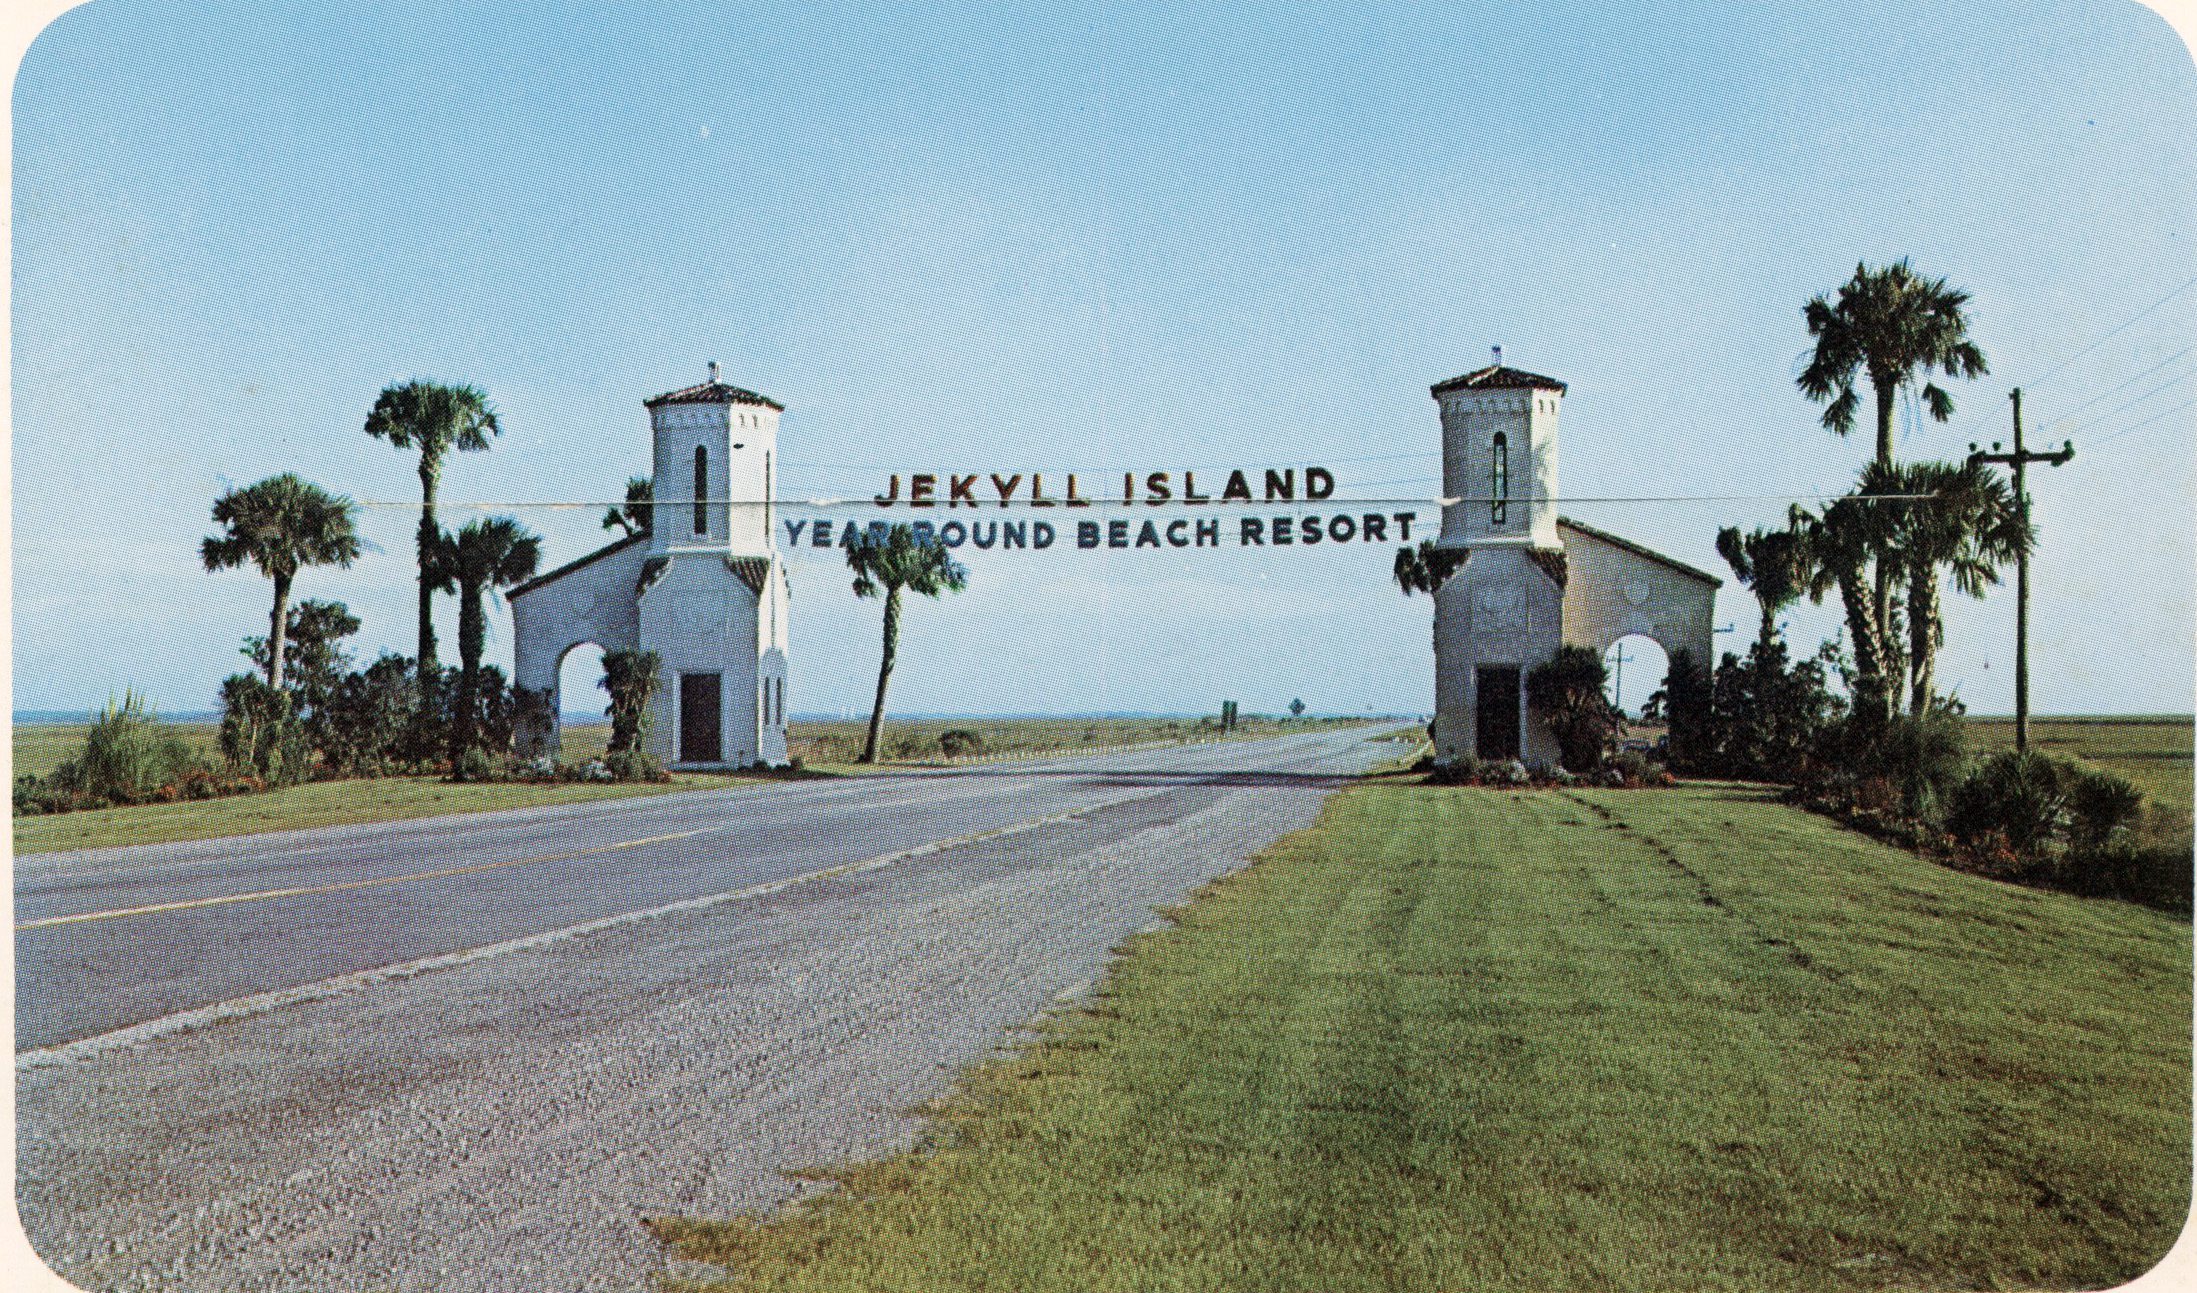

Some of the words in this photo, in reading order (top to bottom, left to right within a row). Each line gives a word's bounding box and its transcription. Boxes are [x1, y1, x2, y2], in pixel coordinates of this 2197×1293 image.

[874, 473, 1091, 508] JEKYLL
[1123, 467, 1335, 506] ISLAND
[784, 520, 891, 548] YEAR
[912, 520, 1056, 549] ROUND
[1077, 518, 1219, 549] BEACH
[1240, 511, 1416, 547] RESORT
